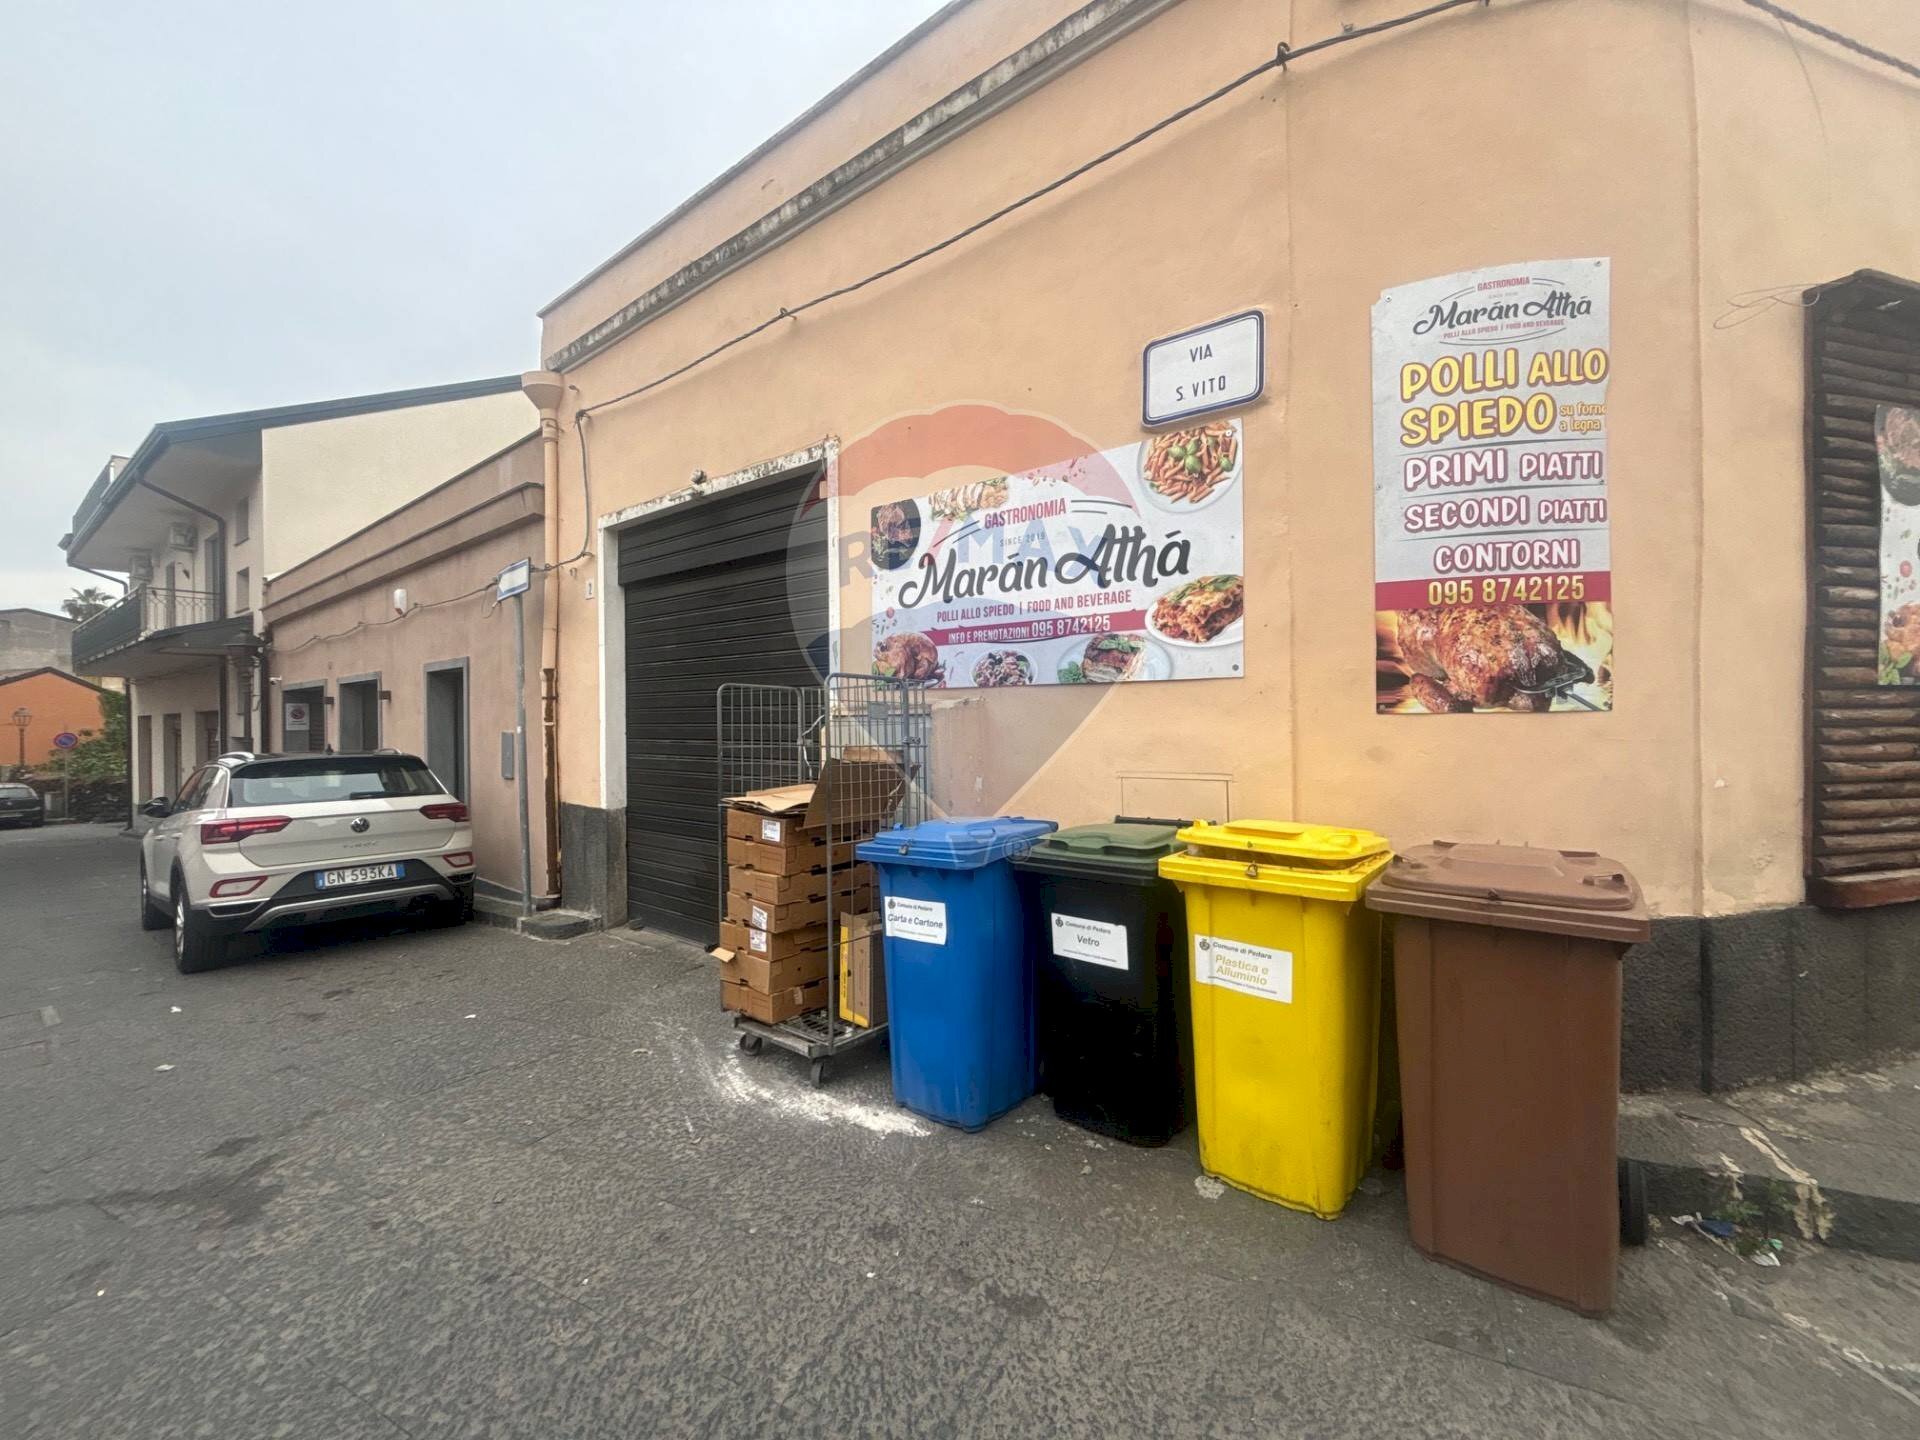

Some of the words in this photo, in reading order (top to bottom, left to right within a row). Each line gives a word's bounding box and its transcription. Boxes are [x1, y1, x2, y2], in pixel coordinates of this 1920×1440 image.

[1477, 276, 1530, 292] GASTRONOMIA
[1413, 300, 1519, 335] Marán
[1523, 290, 1592, 320] Athá
[1189, 344, 1213, 363] VIA
[1192, 374, 1227, 398] VITO
[1401, 349, 1519, 402] POLLI
[1528, 347, 1609, 385] ALLO
[1400, 392, 1558, 447] SPIEDO
[1559, 405, 1574, 417] su
[1559, 420, 1567, 432] a
[1570, 418, 1601, 435] legna
[1404, 448, 1509, 492] PRIMI
[1520, 450, 1604, 480] PIATTI
[984, 498, 1067, 529] GASTRONOMIA
[1404, 495, 1530, 532] SECONDI
[1537, 499, 1608, 523] PIATTI
[898, 548, 1049, 609] Marán
[1055, 523, 1192, 589] Athá
[1433, 539, 1581, 575] CONTORNI
[1428, 579, 1474, 606] 095
[1482, 575, 1585, 603] 8742125
[937, 607, 959, 623] POLLI
[960, 606, 981, 620] ALLO
[983, 603, 1015, 618] SPIEDO
[1027, 600, 1053, 613] FOOD
[1054, 597, 1075, 610] AND
[1077, 589, 1132, 608] BEVERAGE
[948, 632, 966, 644] INFO
[967, 631, 971, 642] E
[973, 626, 1030, 642] PRENOTAZIONI
[1031, 620, 1054, 638] 095
[1056, 615, 1111, 635] 8742125
[327, 870, 346, 885] GN
[350, 865, 394, 881] 593KA
[887, 913, 908, 924] Carta
[913, 917, 944, 929] Cartone
[1076, 933, 1101, 948] Vetro
[1212, 941, 1239, 952] Comune
[1247, 949, 1272, 960] Pedara
[1215, 954, 1258, 972] Plastica
[1215, 965, 1268, 986] Alluminio
